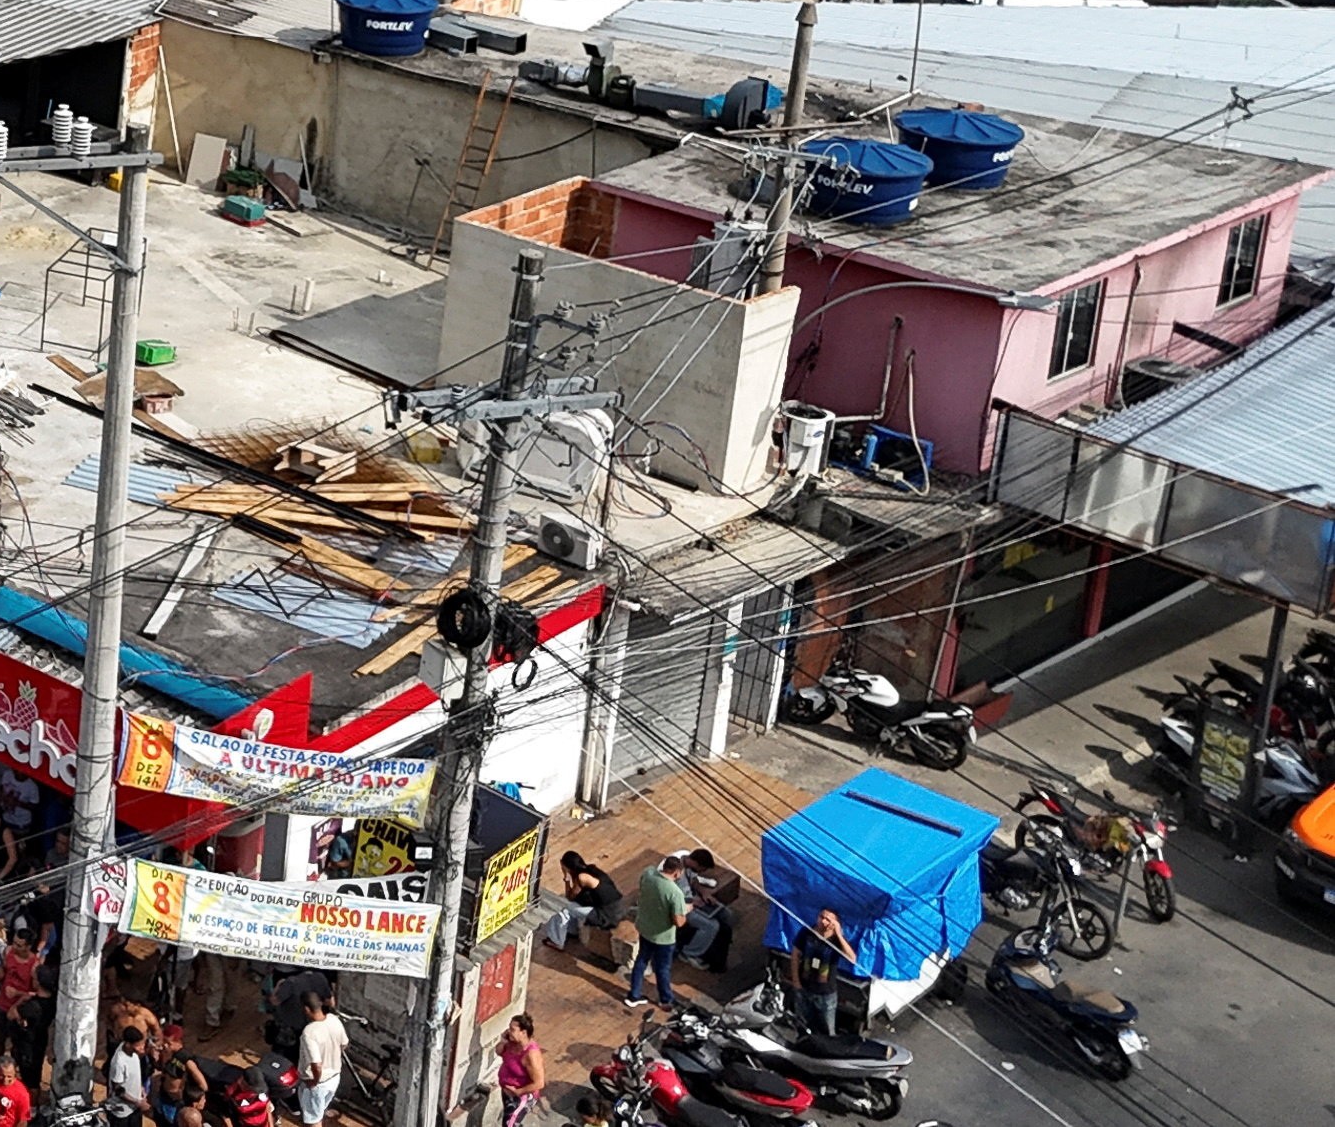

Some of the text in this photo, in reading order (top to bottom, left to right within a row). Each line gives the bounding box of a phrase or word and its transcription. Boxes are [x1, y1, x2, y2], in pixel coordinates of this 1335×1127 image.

[817, 174, 874, 195] FOLEV
[243, 743, 260, 756] DE
[263, 745, 306, 763] FESTA
[136, 761, 163, 775] DEZ
[359, 774, 409, 789] ANO
[152, 868, 174, 882] DIA
[153, 881, 170, 914] 8
[208, 878, 249, 896] EDIÇÃO
[250, 892, 265, 903] DO
[266, 894, 284, 905] DIA
[286, 897, 300, 908] DO
[303, 890, 343, 907] GRUPO
[300, 902, 362, 928] NOSSO
[366, 909, 427, 933] LANCE
[188, 913, 202, 924] NO
[204, 914, 244, 932] ESPAÇO
[246, 921, 259, 934] DE
[262, 924, 299, 940] BELEZA
[315, 931, 361, 949] BRONZE
[363, 940, 383, 952] DAS
[385, 942, 427, 953] MANAS
[264, 939, 315, 956] JAILSON
